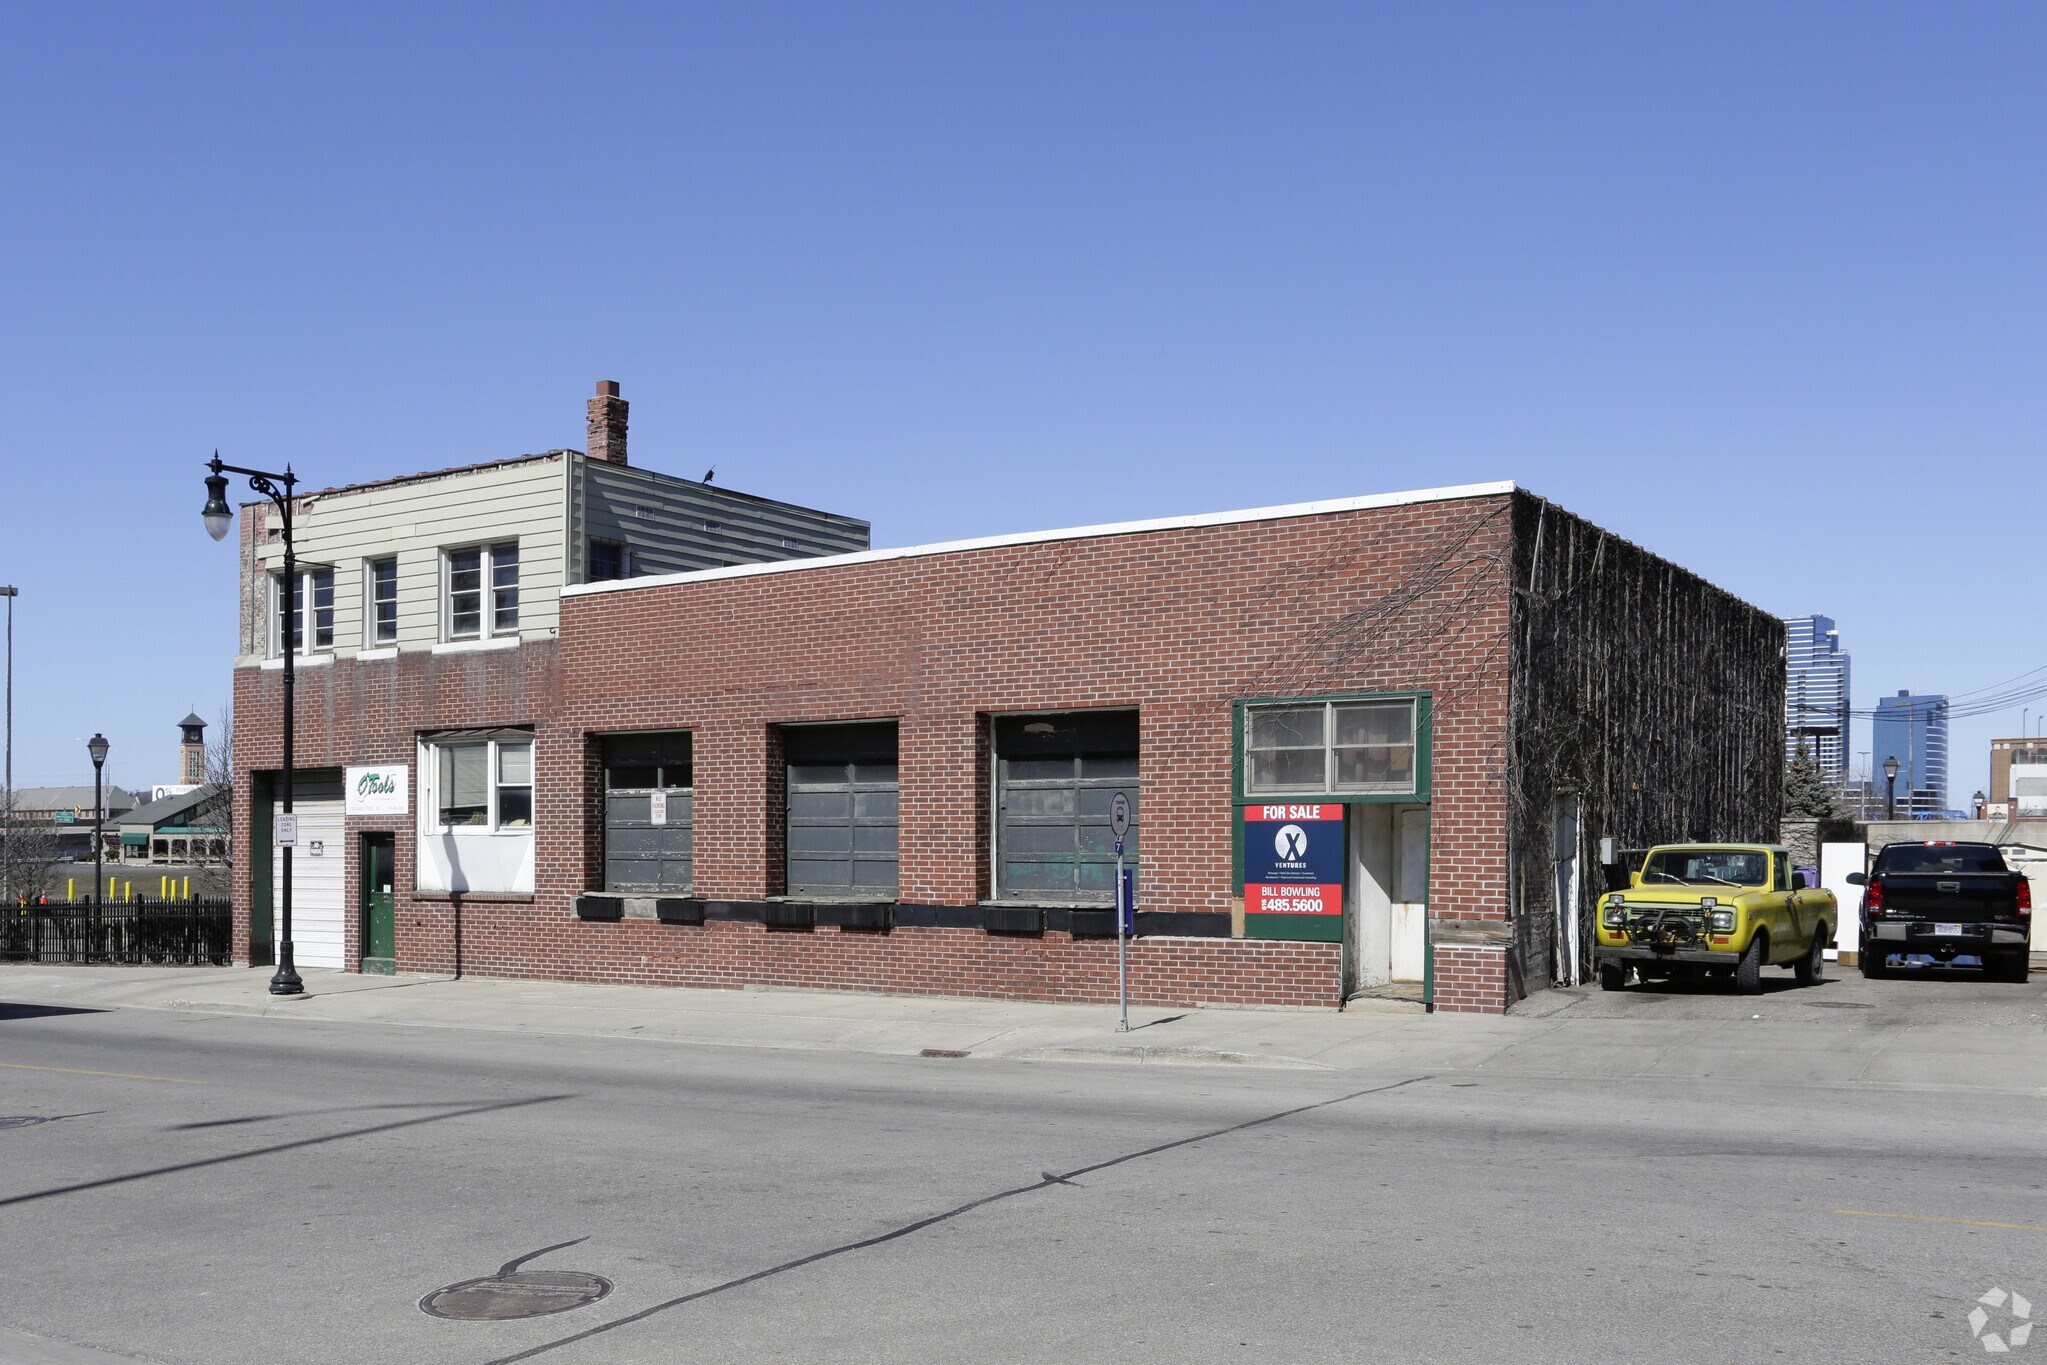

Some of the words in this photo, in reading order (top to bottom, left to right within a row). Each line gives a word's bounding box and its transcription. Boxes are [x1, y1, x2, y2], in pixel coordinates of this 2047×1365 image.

[1263, 806, 1286, 819] FOR
[1289, 805, 1320, 819] SALE
[1116, 843, 1121, 851] 7
[1261, 887, 1278, 896] BILL
[1280, 887, 1320, 896] BOWLING
